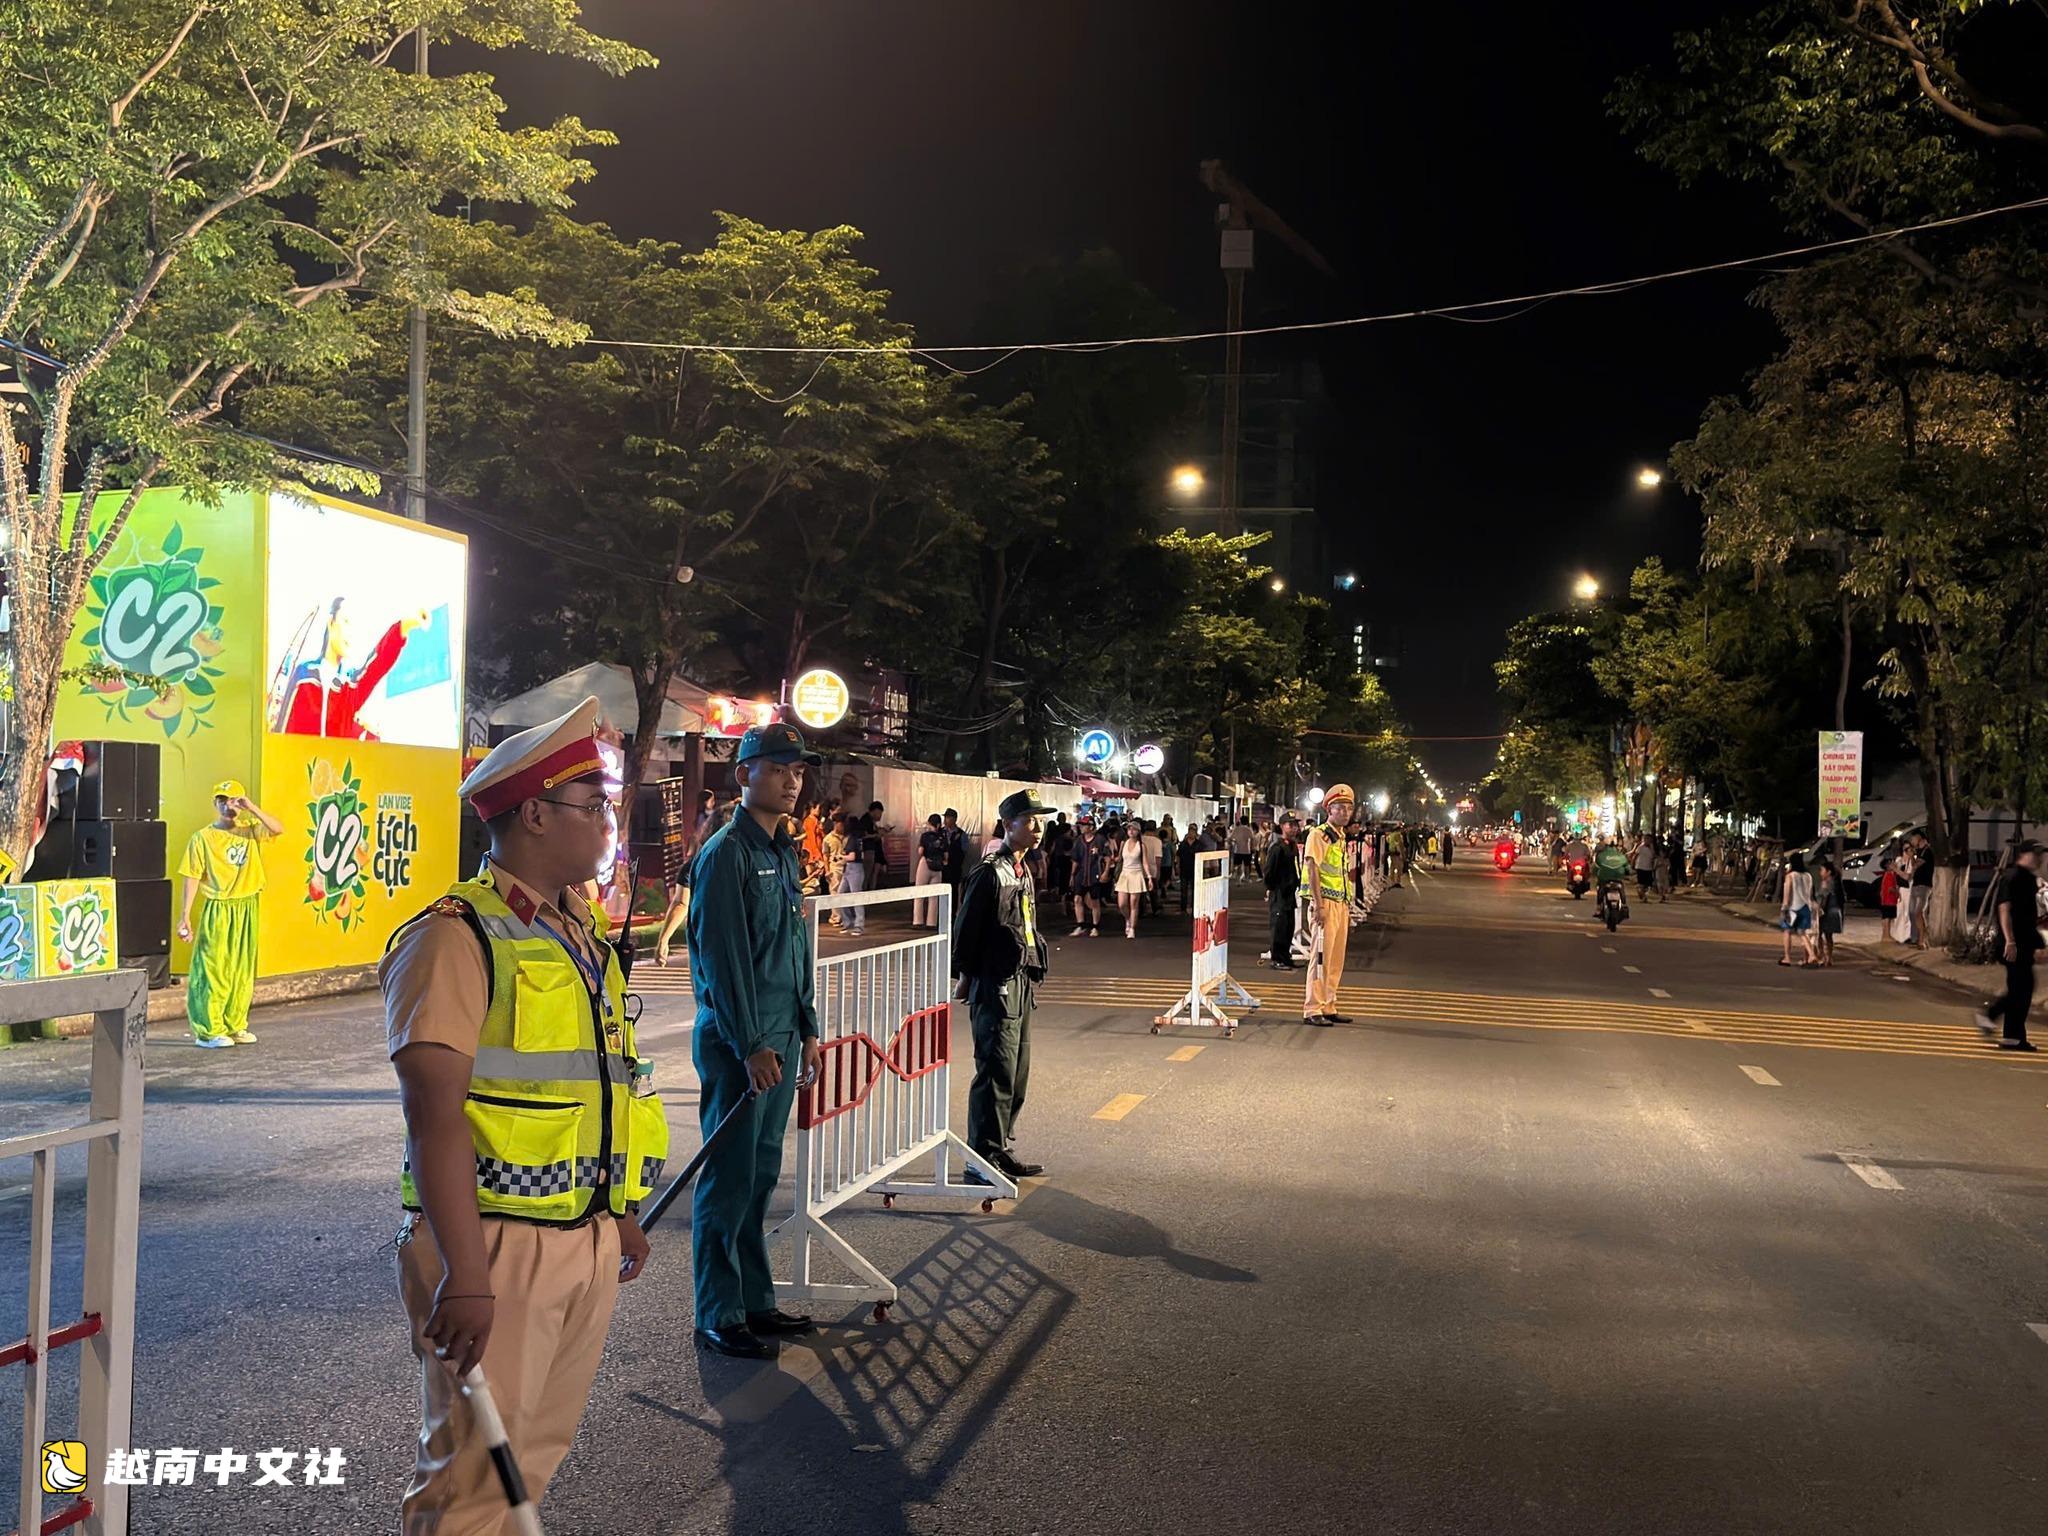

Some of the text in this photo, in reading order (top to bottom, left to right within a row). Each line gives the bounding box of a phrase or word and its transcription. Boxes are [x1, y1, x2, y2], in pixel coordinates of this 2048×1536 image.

[105, 577, 203, 677] C2
[378, 795, 411, 810] LAN VIBE
[316, 803, 361, 885] C2
[377, 811, 417, 856] tích
[373, 851, 410, 897] cực
[0, 915, 20, 960] 2
[64, 905, 100, 960] C2
